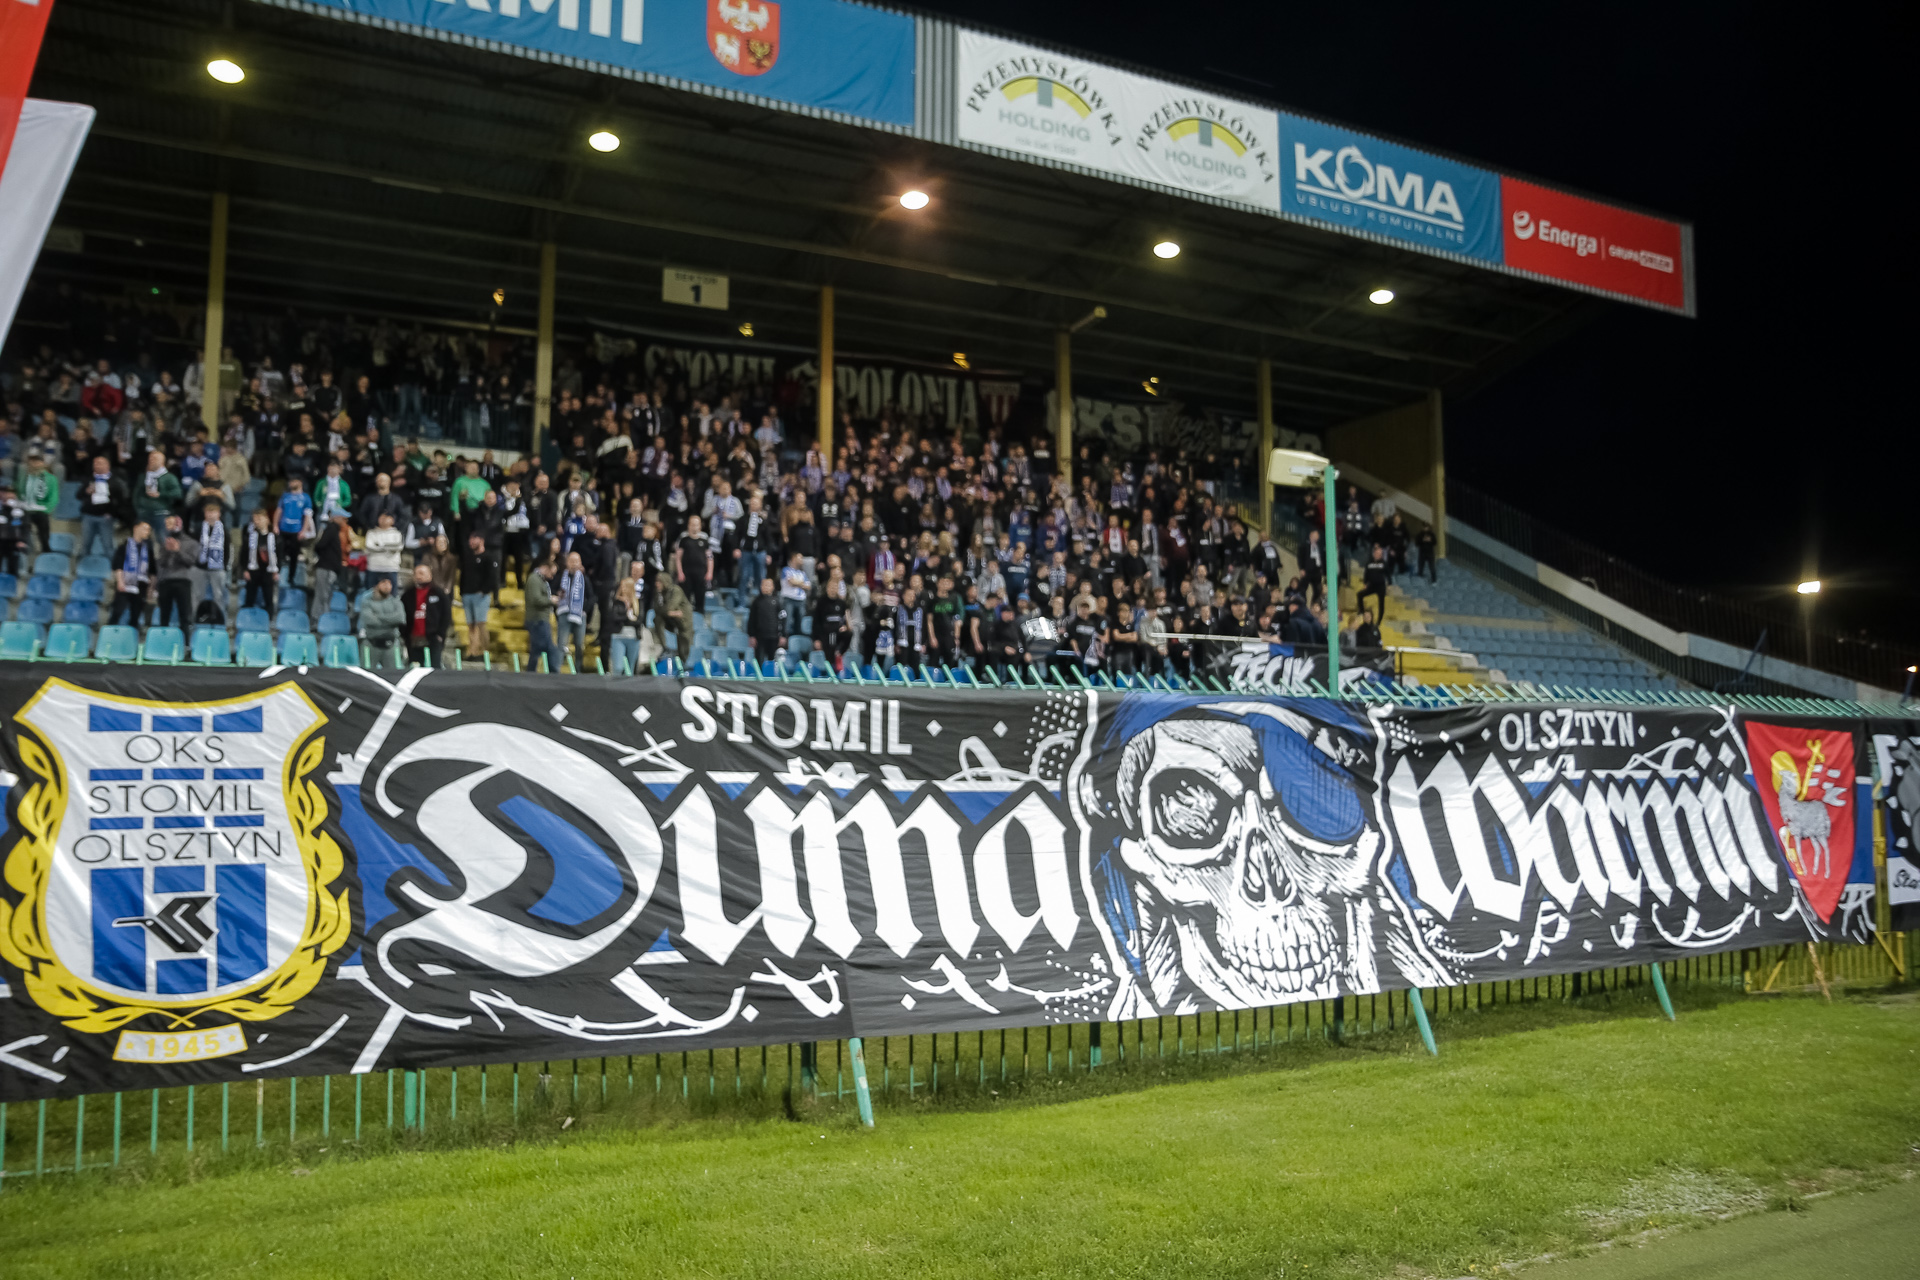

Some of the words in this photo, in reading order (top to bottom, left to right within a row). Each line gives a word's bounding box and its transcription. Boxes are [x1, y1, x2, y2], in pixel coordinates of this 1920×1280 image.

[999, 107, 1092, 143] HOLDING
[1164, 148, 1247, 180] HOLDING
[1294, 142, 1464, 224] KOMA
[1366, 209, 1465, 245] KOMUNALNE
[1538, 219, 1598, 257] Energa
[690, 284, 702, 305] 1
[680, 685, 913, 757] STOMIL
[1500, 709, 1636, 752] OLSZTYN
[125, 735, 225, 763] OKS
[89, 784, 265, 815] STOMIL
[72, 830, 282, 863] OLSZTYN
[375, 722, 1082, 977] Duma
[1388, 750, 1779, 922] Warmii
[145, 1037, 221, 1058] 1945
